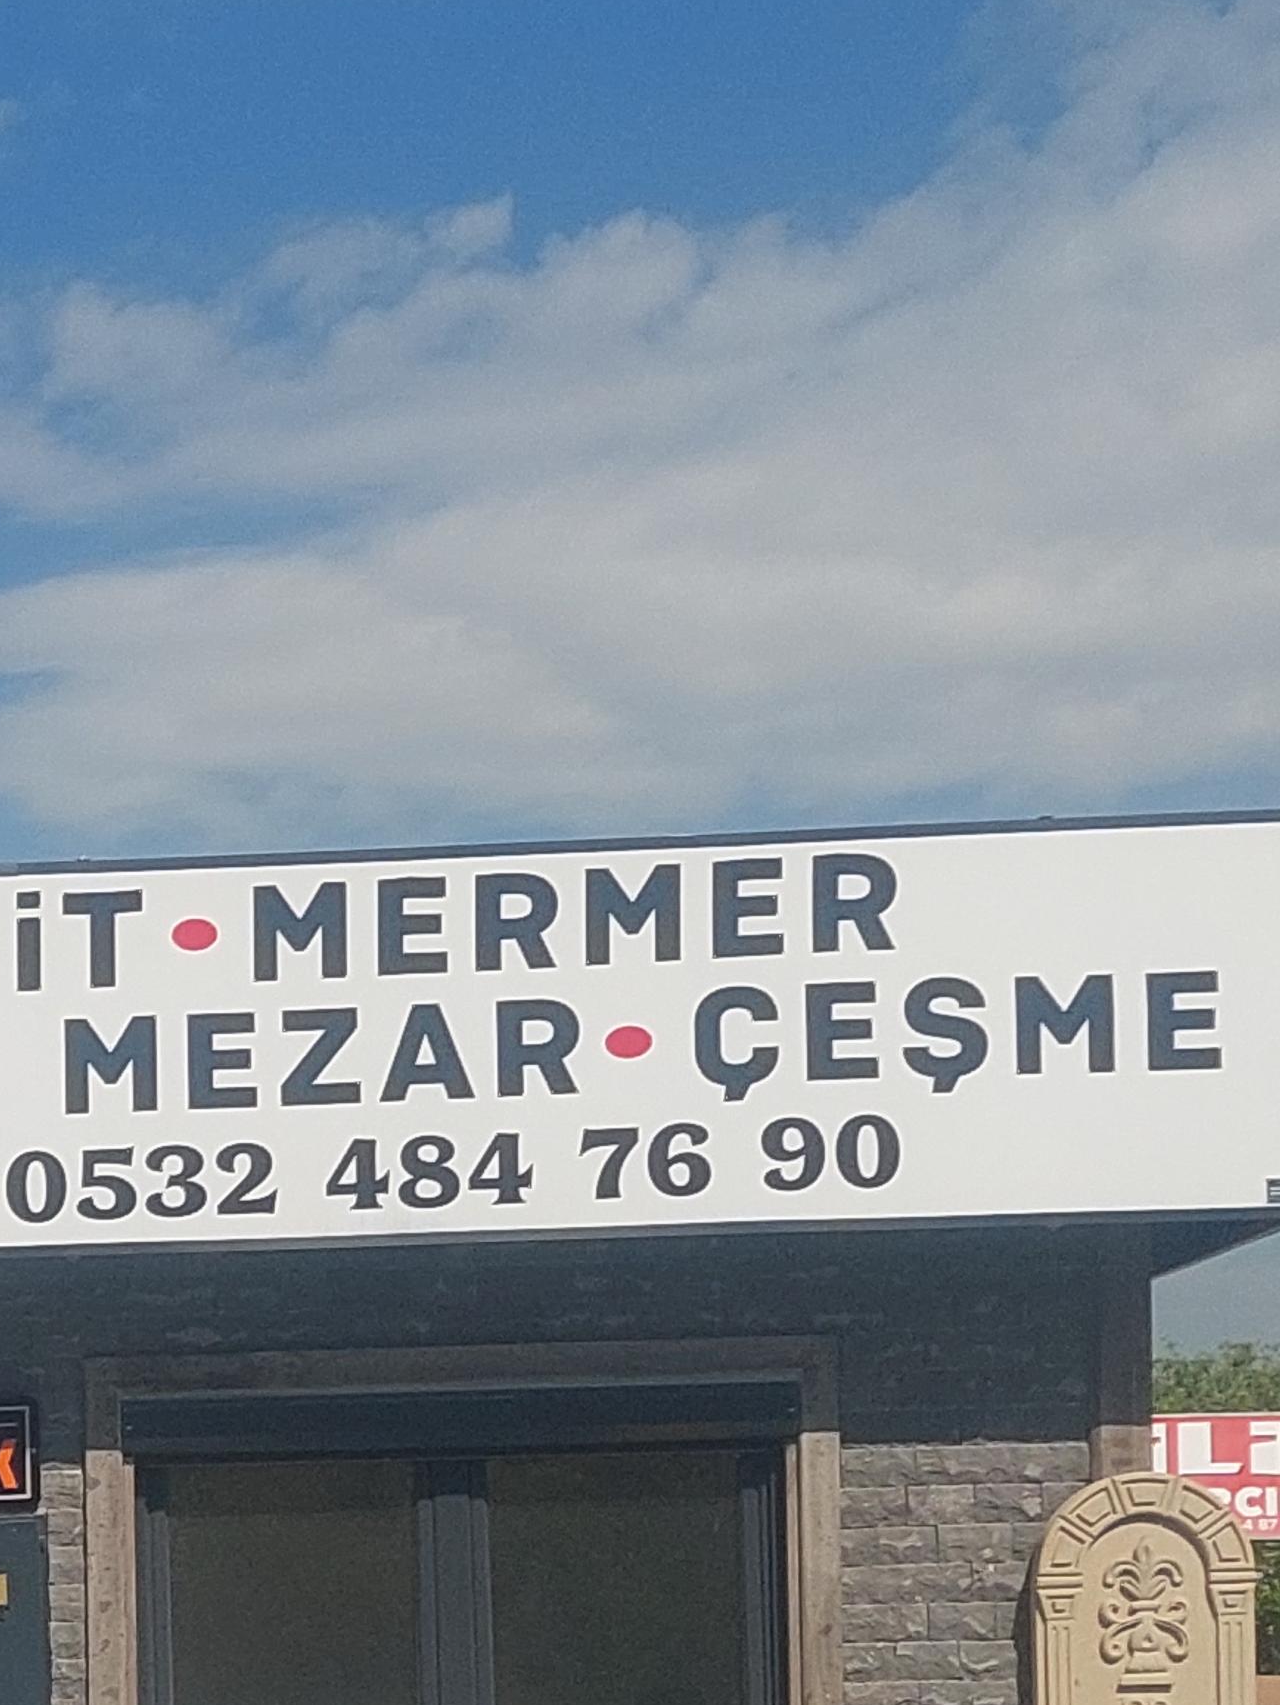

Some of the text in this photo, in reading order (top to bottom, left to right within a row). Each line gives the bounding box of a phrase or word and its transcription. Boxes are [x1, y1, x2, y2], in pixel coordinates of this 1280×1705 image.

[253, 853, 898, 983] MERMER
[64, 970, 1223, 1115] MEZAR ÇEŞME
[6, 1114, 900, 1223] 0532 484 76 90
